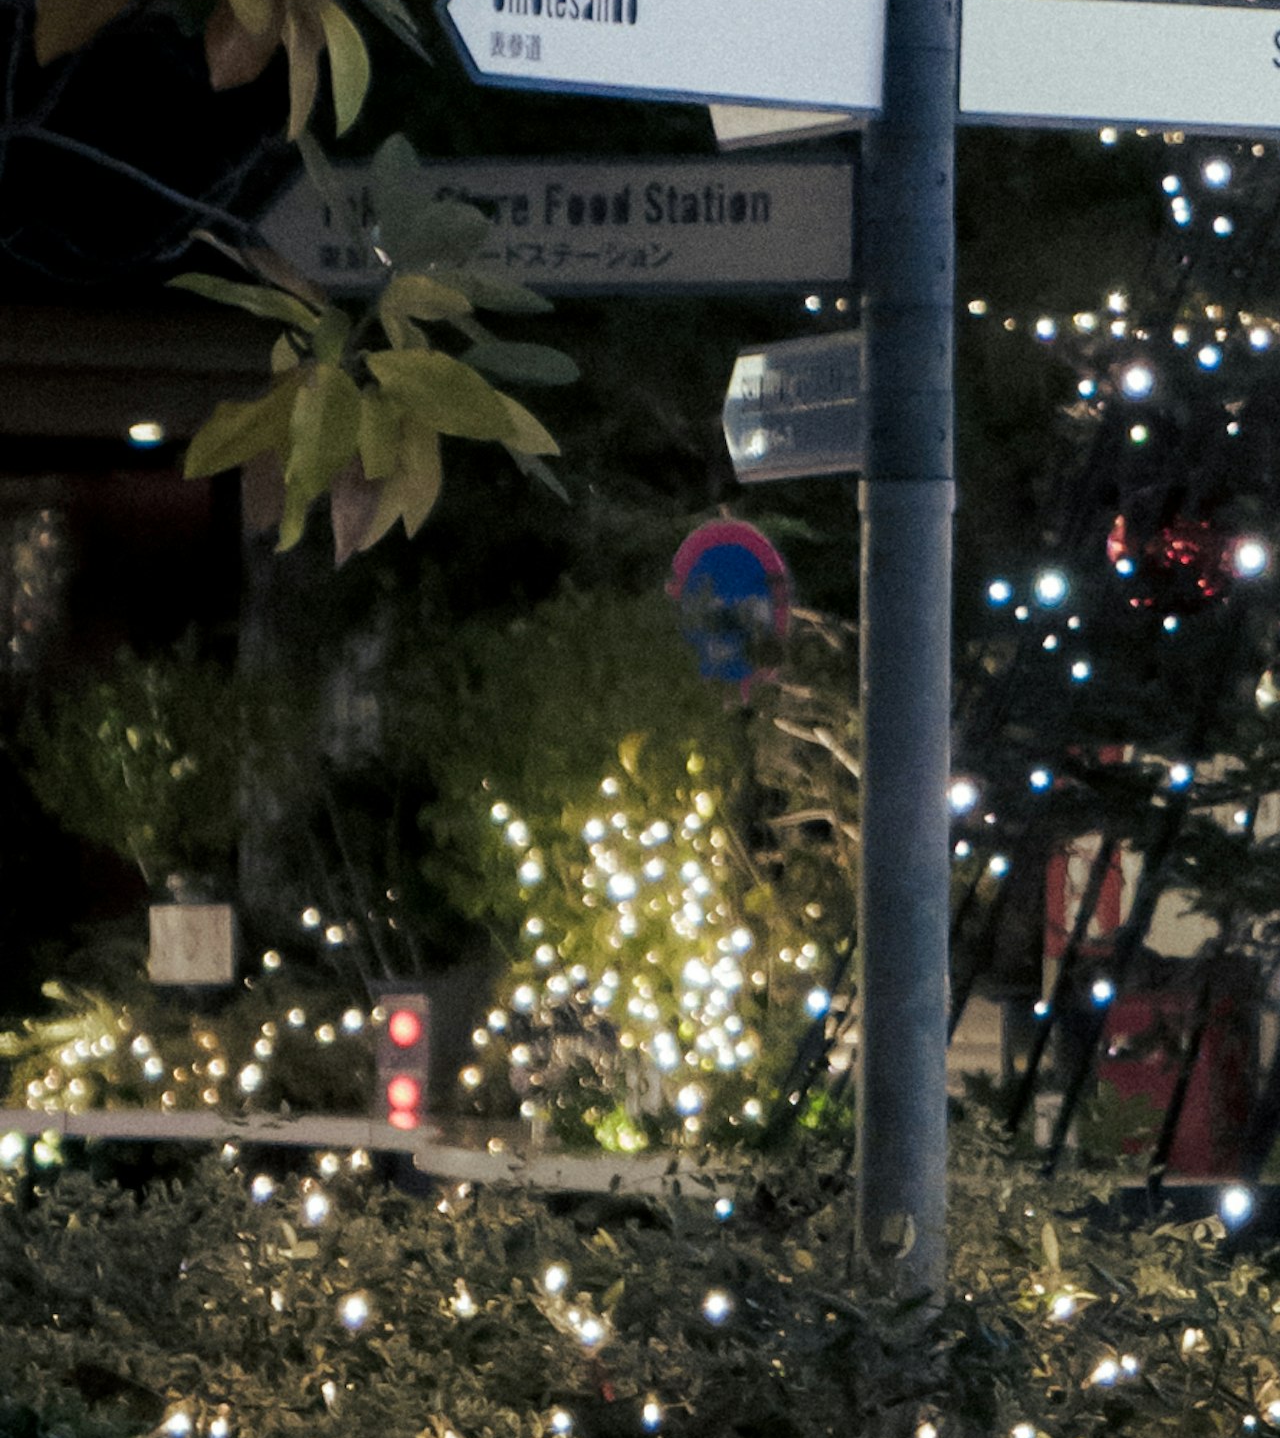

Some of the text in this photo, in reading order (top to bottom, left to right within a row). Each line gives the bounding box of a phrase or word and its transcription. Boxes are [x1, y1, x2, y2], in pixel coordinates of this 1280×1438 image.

[490, 31, 541, 60] 表参道
[544, 183, 630, 225] Food
[645, 182, 771, 224] Station
